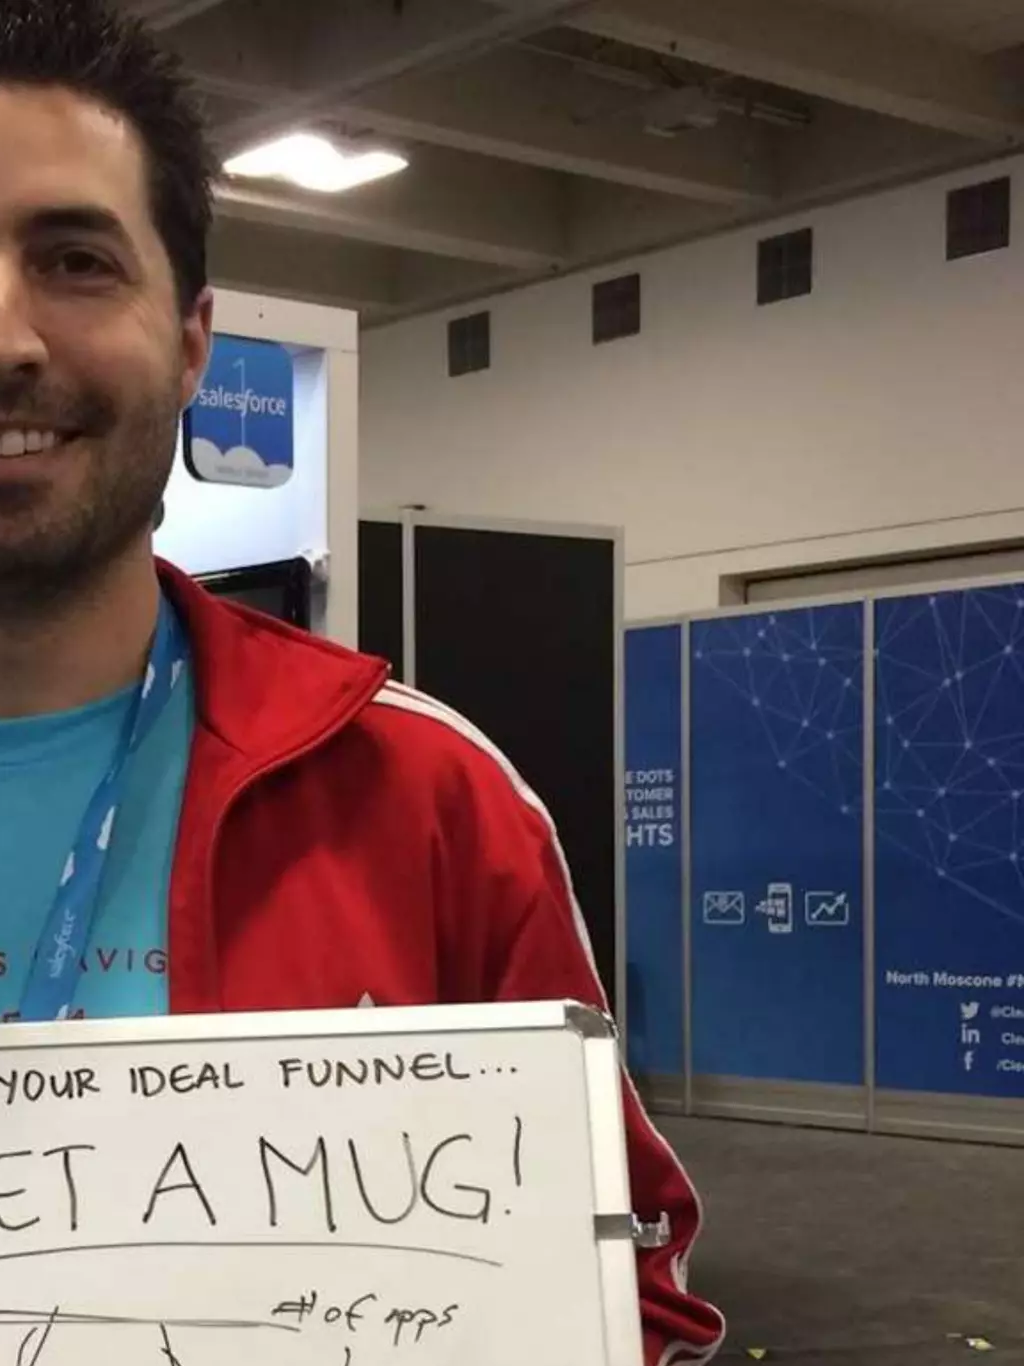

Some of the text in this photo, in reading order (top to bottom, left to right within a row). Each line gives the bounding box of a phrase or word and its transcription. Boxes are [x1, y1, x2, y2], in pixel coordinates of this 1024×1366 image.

[199, 386, 287, 418] salesforce
[637, 769, 674, 784] DOTS
[627, 823, 674, 848] HTS
[886, 971, 929, 985] North
[933, 972, 1003, 987] Moscone
[129, 1064, 244, 1098] IDEAL
[142, 1142, 217, 1226] A
[259, 1116, 523, 1233] MUG!
[324, 1293, 377, 1332] of
